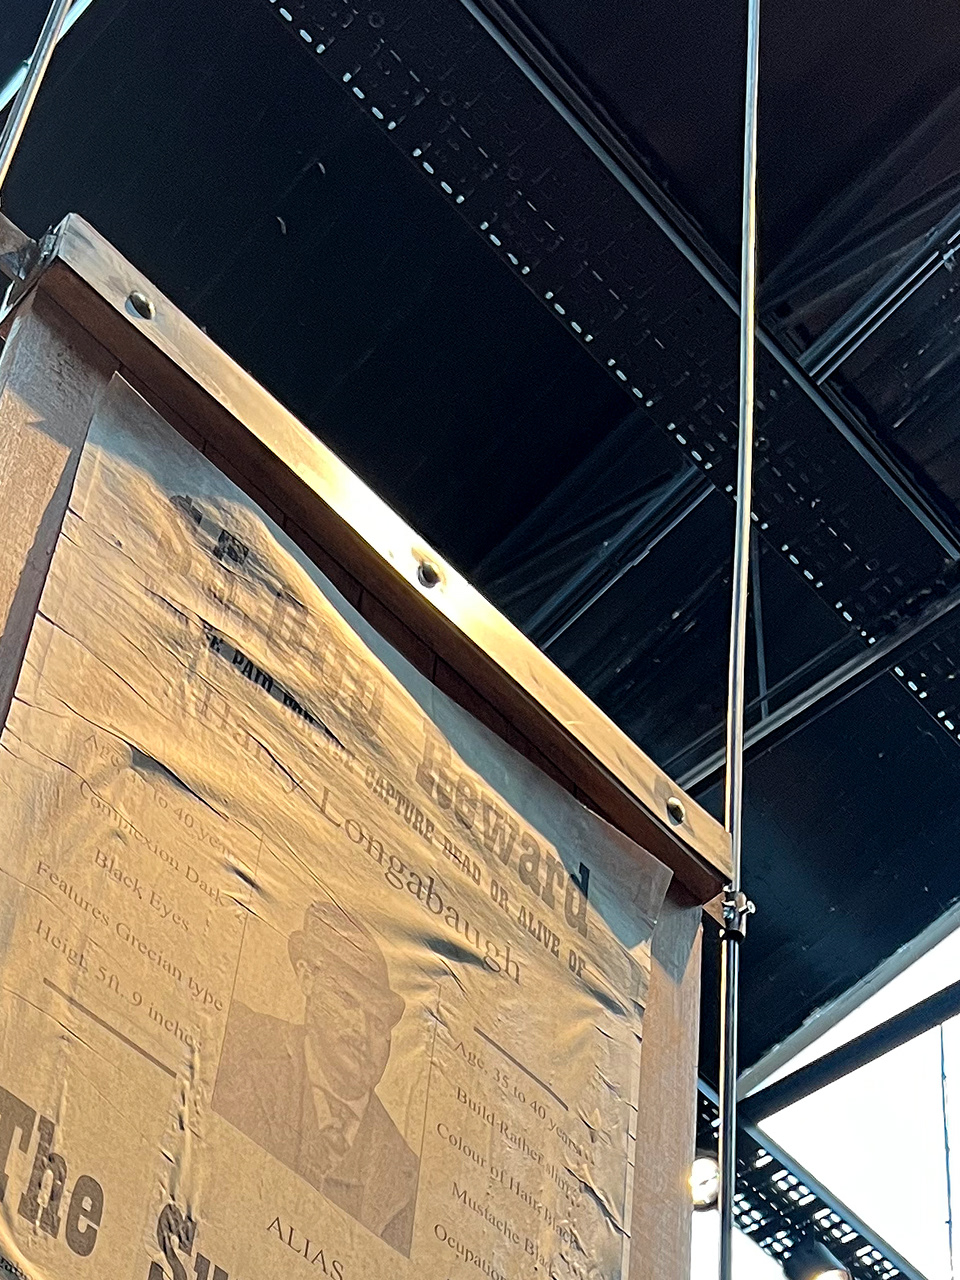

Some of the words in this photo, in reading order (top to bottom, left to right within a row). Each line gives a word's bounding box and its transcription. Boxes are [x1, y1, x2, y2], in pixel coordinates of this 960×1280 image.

[174, 804, 194, 828] 40
[415, 718, 590, 938] Reward
[93, 848, 142, 897] Black
[148, 889, 189, 931] Eyes
[184, 864, 223, 906] Dark
[318, 786, 520, 986] Longabaugh
[363, 764, 435, 845] CAPTURE
[441, 835, 482, 887] DEAD
[489, 877, 511, 914] OR
[516, 904, 561, 959] ALIVE
[568, 948, 586, 981] OF
[38, 859, 109, 926] Features
[115, 921, 182, 982] Grecian
[188, 977, 223, 1011] type
[131, 989, 143, 1008] 9
[147, 1000, 202, 1053] inches
[454, 1040, 487, 1076] Age,
[492, 1067, 509, 1089] 35
[513, 1086, 526, 1103] to
[529, 1098, 546, 1120] 40
[437, 1121, 486, 1170] Colour
[489, 1165, 505, 1183] of
[452, 1181, 519, 1244] Mustache
